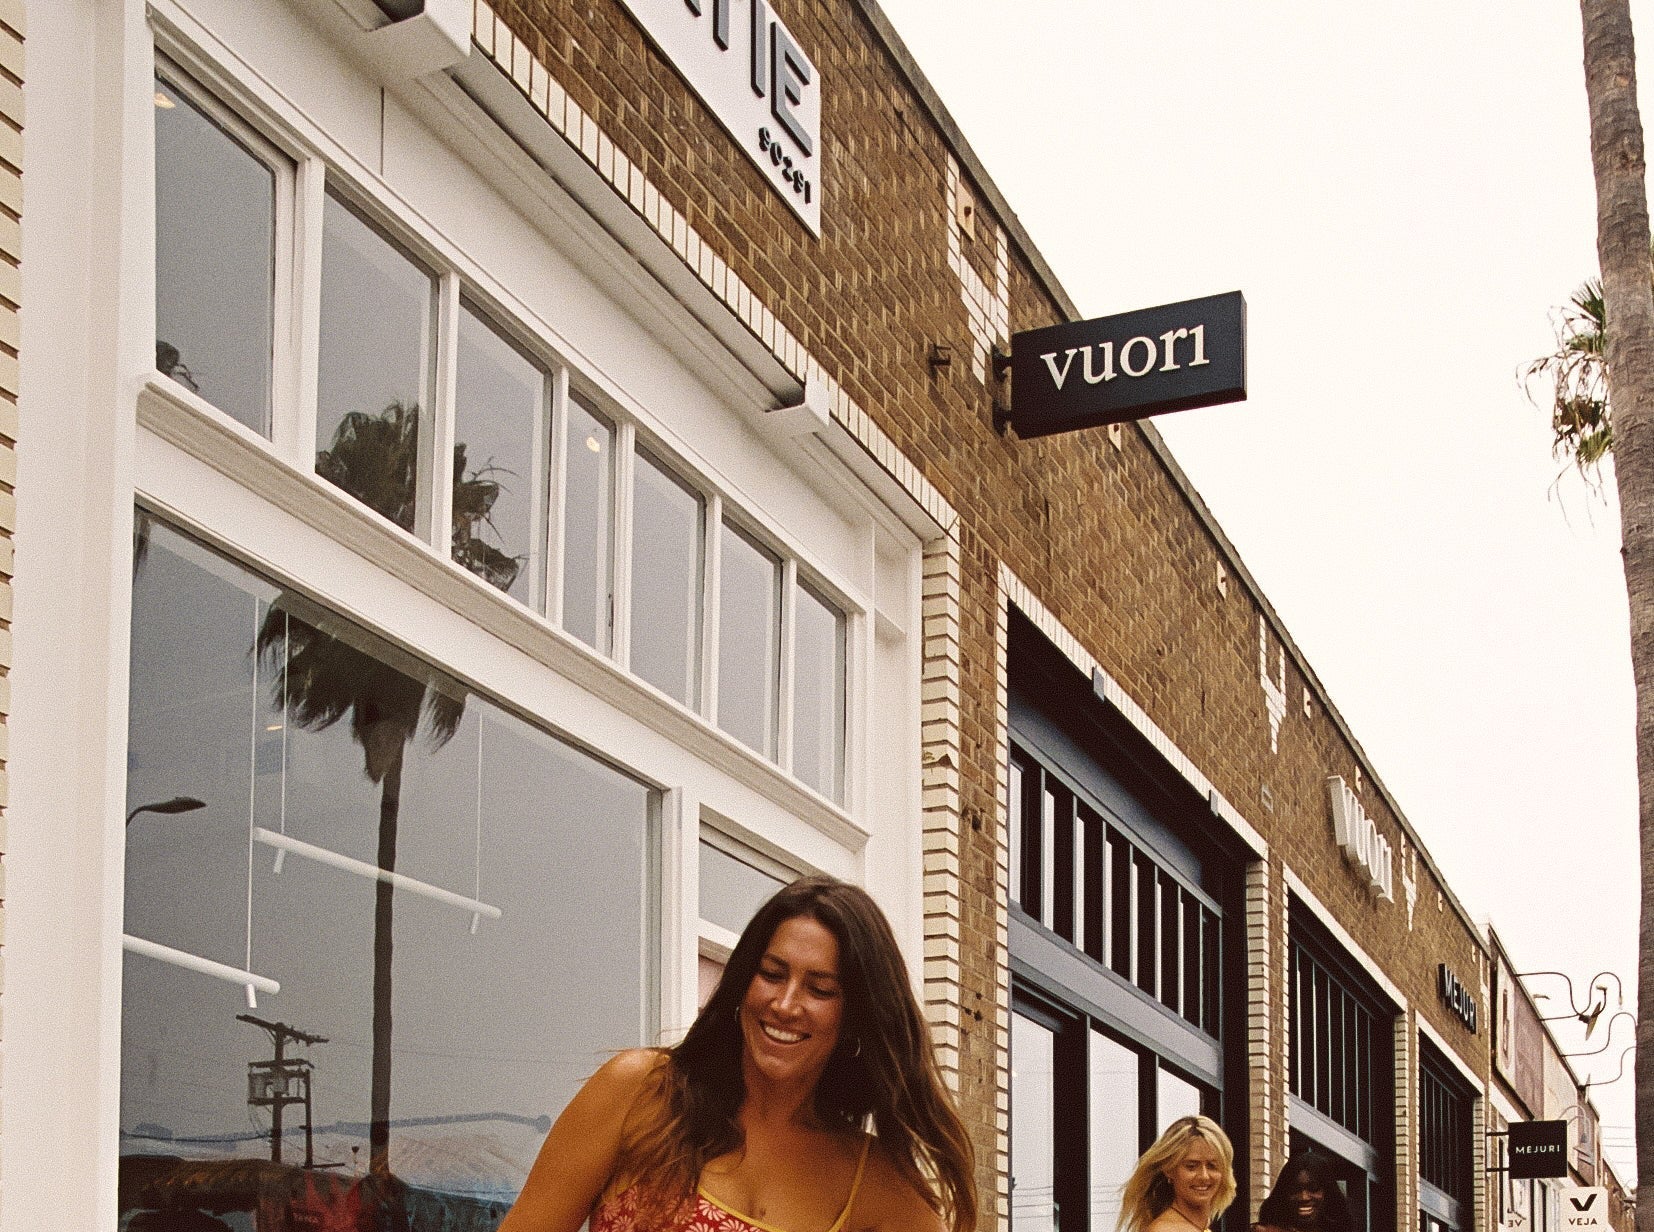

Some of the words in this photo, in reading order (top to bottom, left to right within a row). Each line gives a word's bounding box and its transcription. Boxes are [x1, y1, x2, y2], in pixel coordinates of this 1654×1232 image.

[1040, 324, 1210, 391] vuori
[1515, 1144, 1560, 1154] MEJURI
[1568, 1217, 1598, 1226] VEJA
